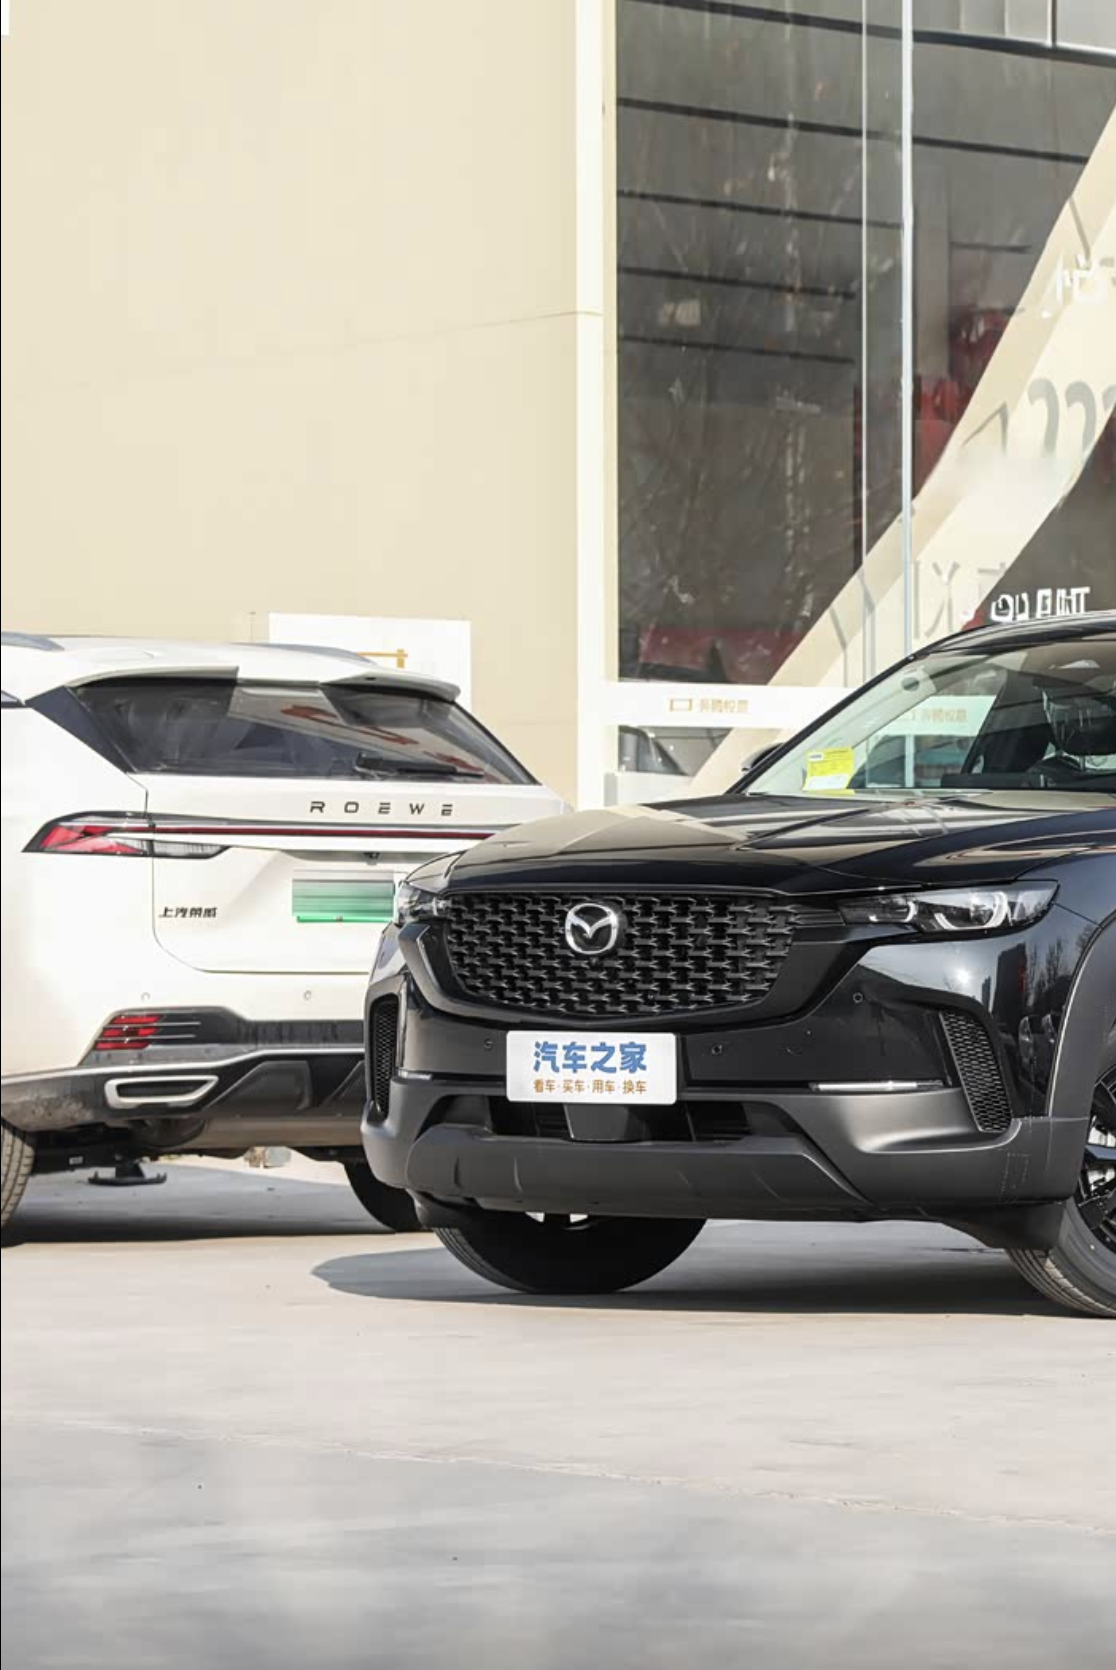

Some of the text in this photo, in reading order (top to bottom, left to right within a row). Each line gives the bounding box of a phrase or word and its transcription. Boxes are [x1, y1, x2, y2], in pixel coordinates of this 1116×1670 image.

[309, 800, 453, 817] ROEWE
[158, 906, 218, 919] 上汽荣威
[533, 1041, 647, 1074] 汽车之家
